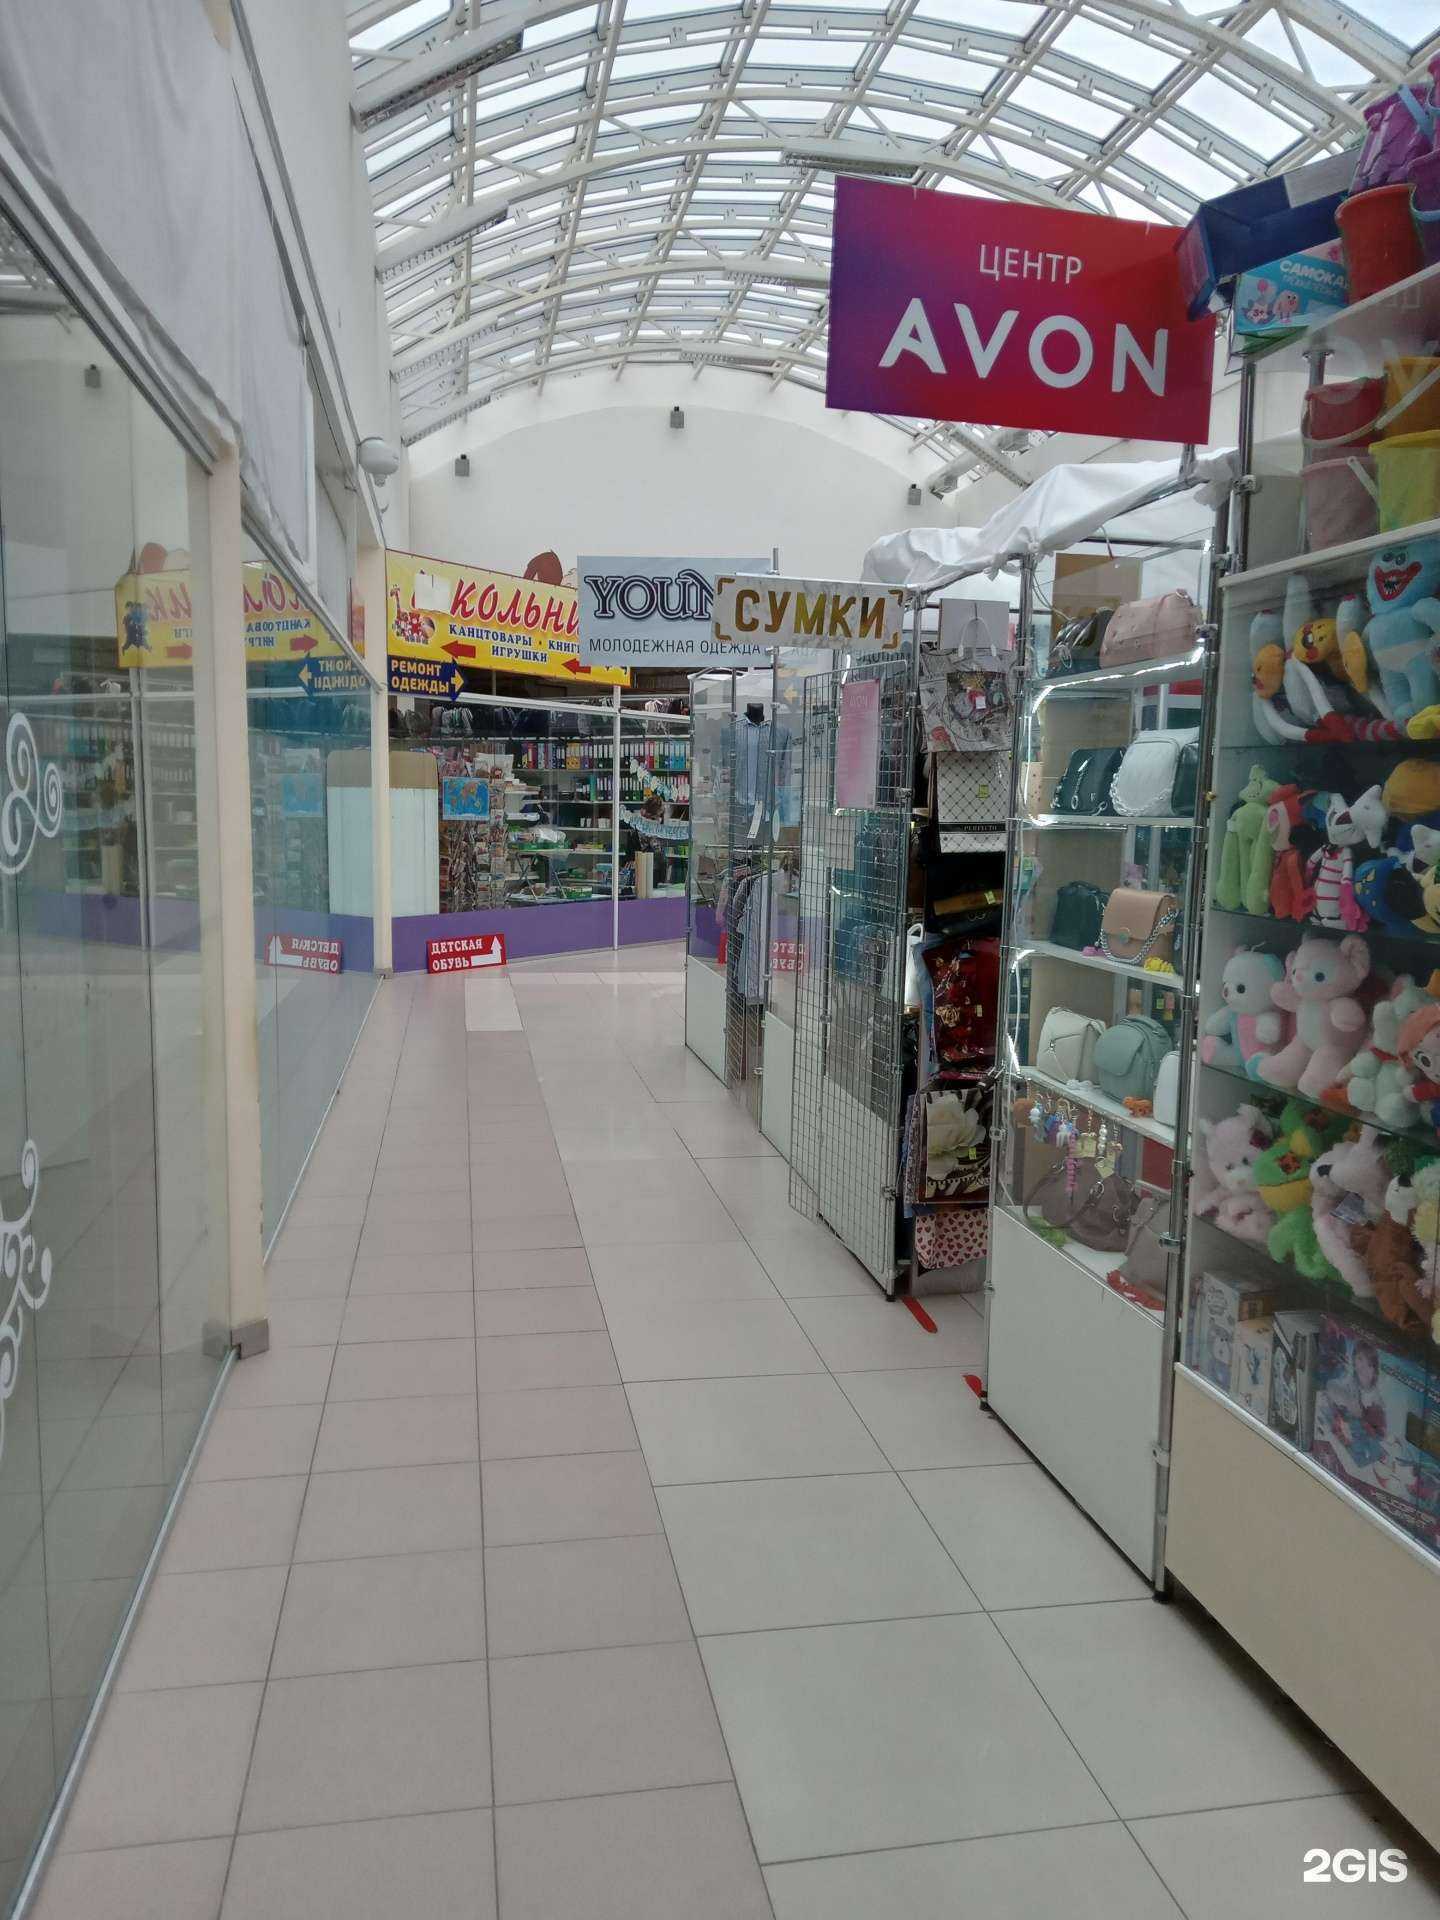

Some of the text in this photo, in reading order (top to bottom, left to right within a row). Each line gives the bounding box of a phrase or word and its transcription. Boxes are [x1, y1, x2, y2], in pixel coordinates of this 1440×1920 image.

[979, 243, 1083, 284] ЦЕНТР
[878, 297, 1168, 397] AVON
[735, 588, 887, 640] СУМКИ
[448, 623, 533, 647] КАНЦТОВАРЫ
[491, 646, 548, 663] ИГРУШКИ
[589, 638, 761, 657] МОЛОДЕЖНАЯ ОДЕЖДА
[391, 658, 442, 677] РЕМОНТ
[391, 675, 449, 694] ОДЕЖДЫ
[431, 938, 483, 955] ДЕТСКАЯ
[432, 956, 470, 971] ОБУВЬ
